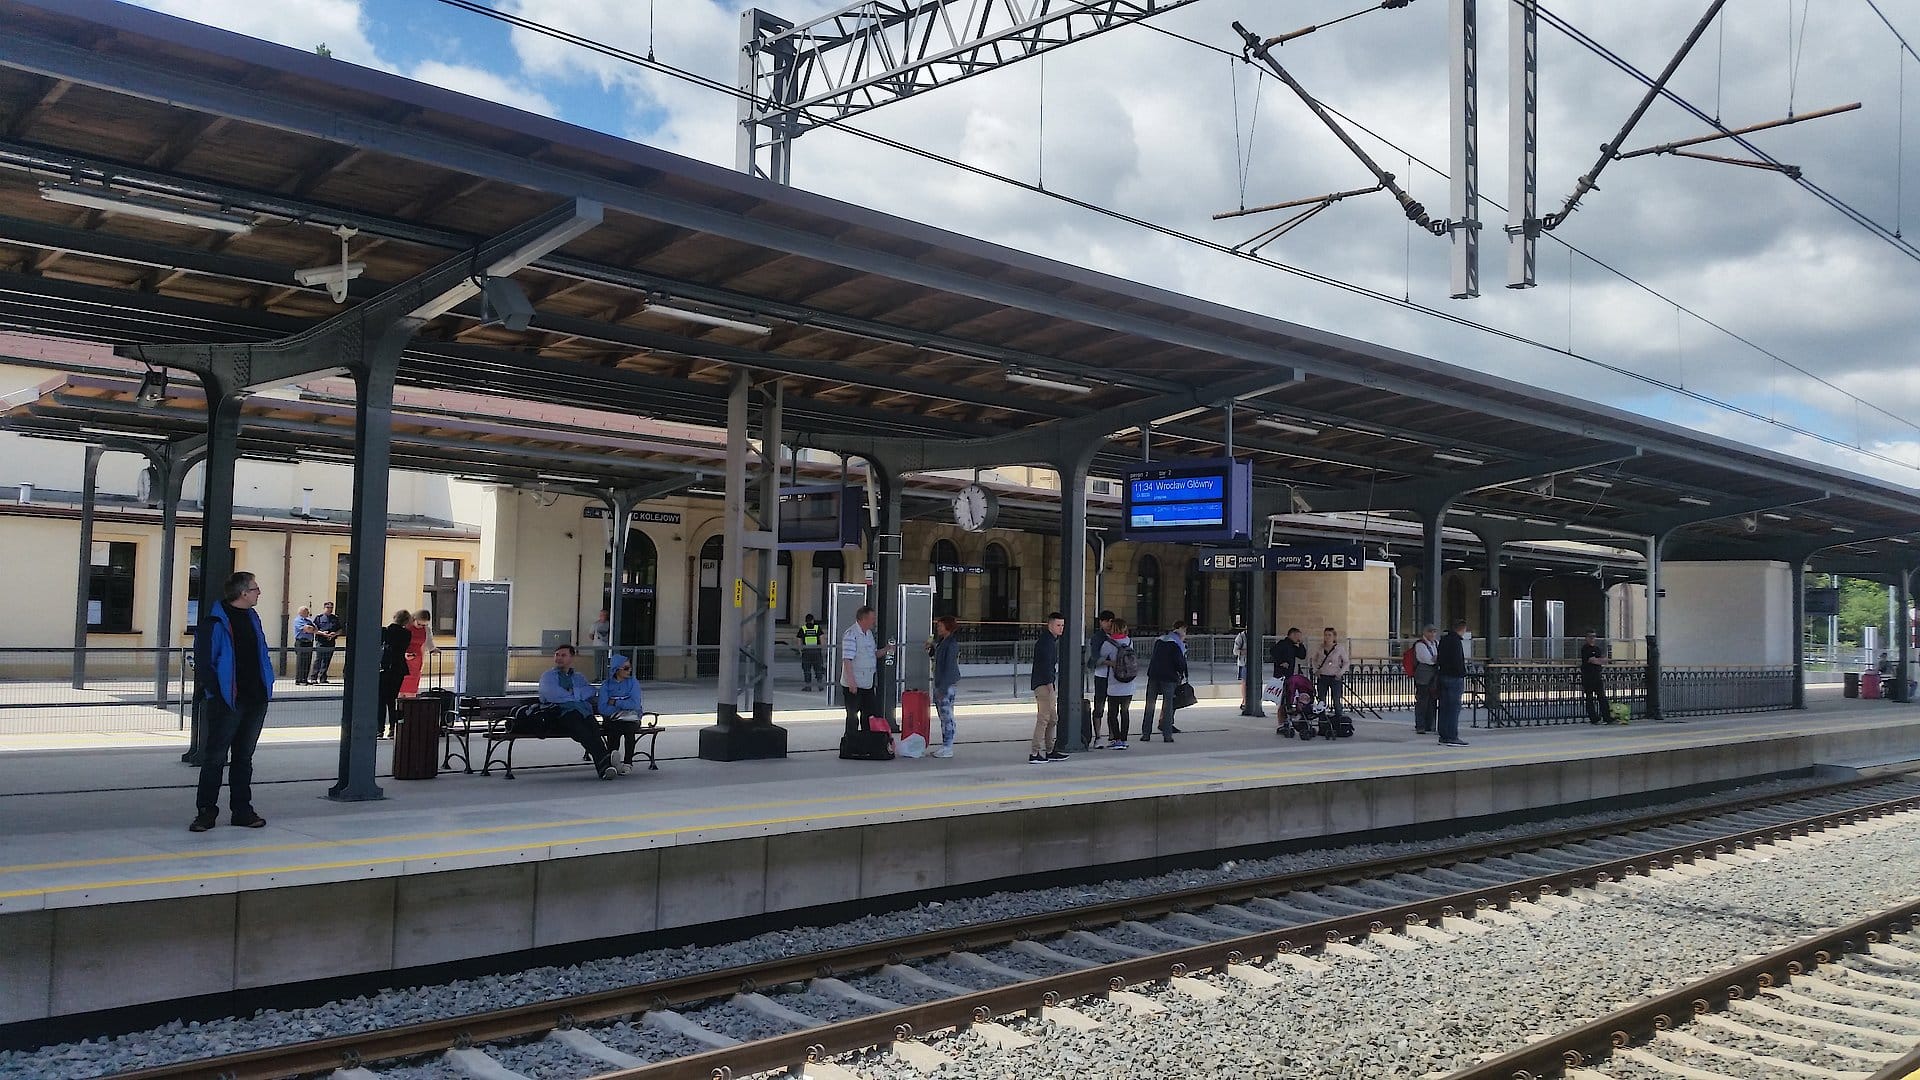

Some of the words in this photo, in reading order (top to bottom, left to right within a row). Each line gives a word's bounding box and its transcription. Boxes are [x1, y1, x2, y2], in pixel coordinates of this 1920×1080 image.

[1156, 481, 1186, 490] Wrocław
[1186, 479, 1214, 490] Główny
[639, 512, 680, 523] KOLEJOWY
[1238, 556, 1258, 564] peron
[1259, 554, 1265, 569] 1
[1277, 555, 1302, 565] perony
[1320, 554, 1330, 568] 4
